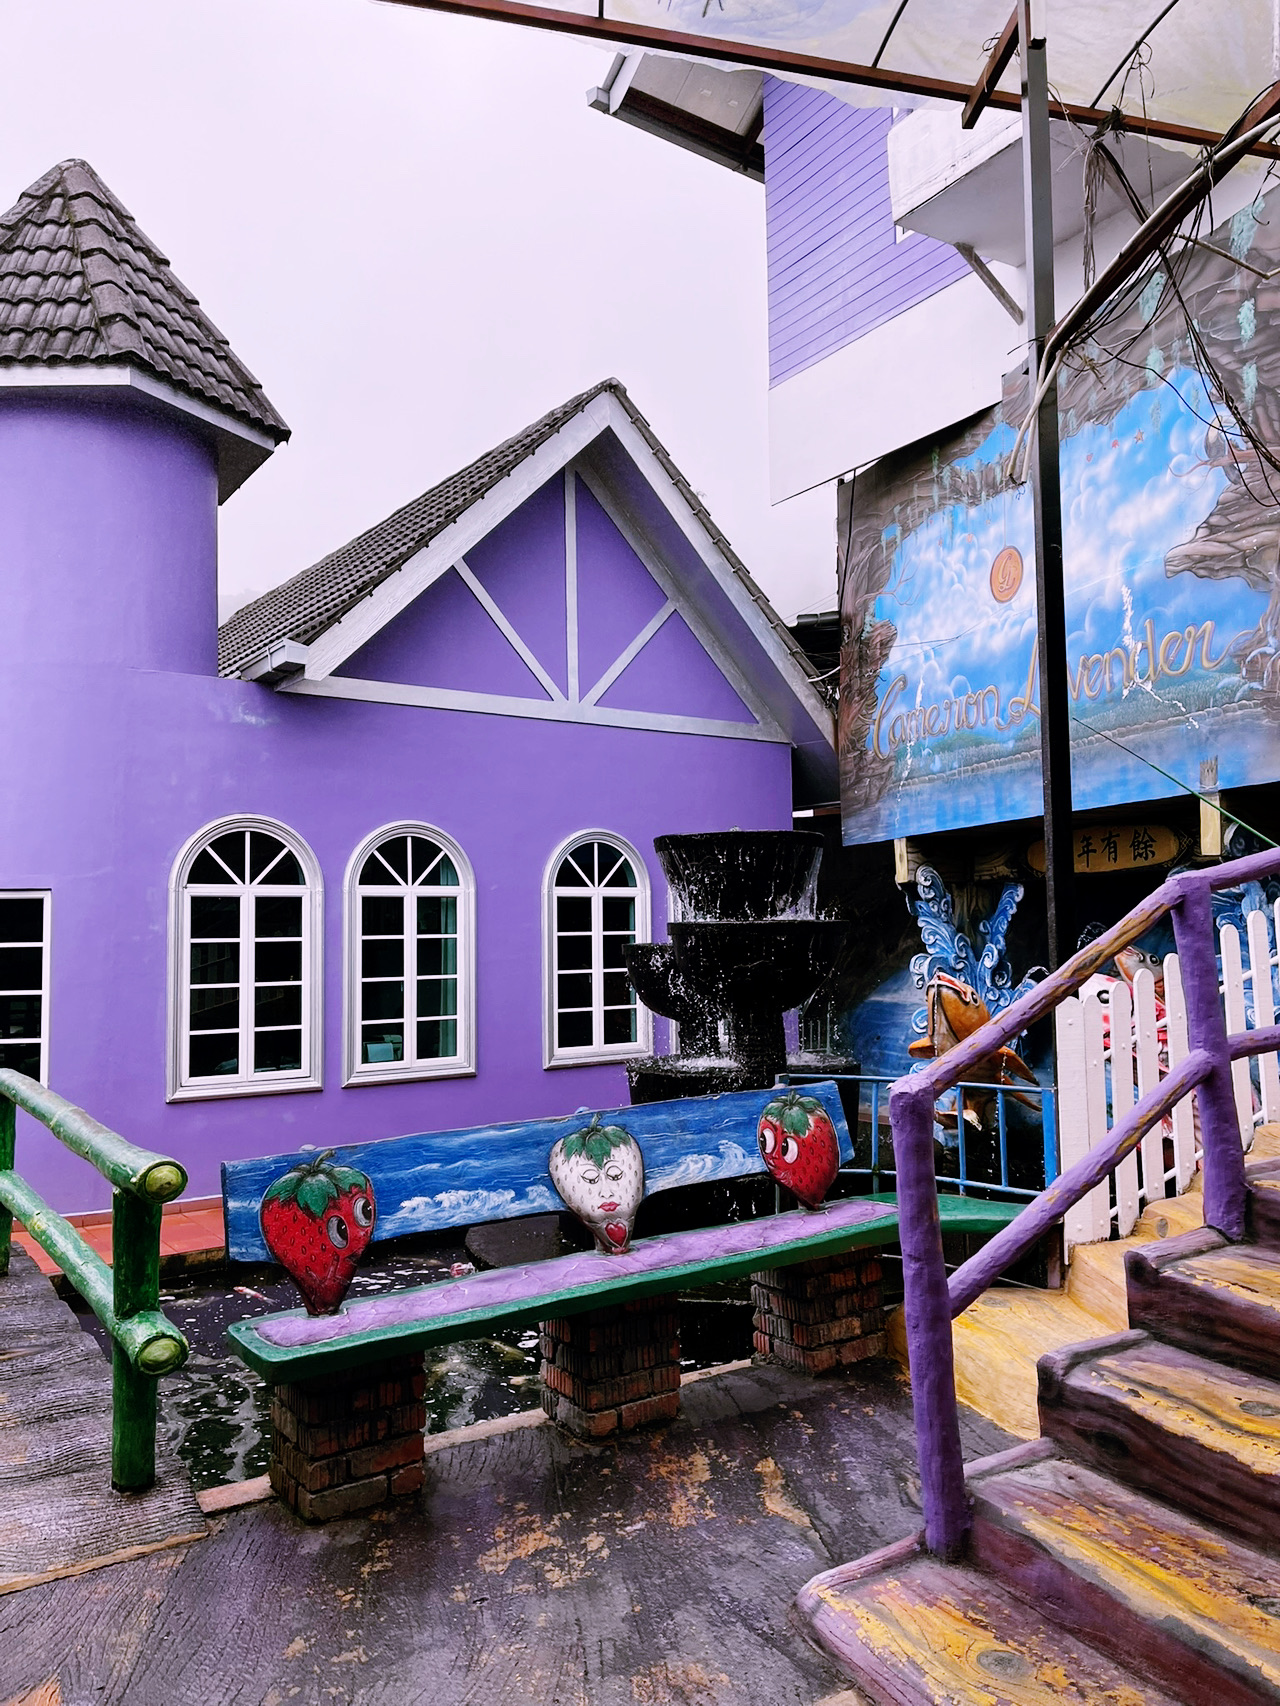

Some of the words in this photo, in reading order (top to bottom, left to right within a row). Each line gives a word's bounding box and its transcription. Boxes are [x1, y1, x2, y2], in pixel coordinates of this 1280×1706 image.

[872, 673, 1008, 760] Cameron
[1008, 618, 1232, 725] Lvender
[1076, 827, 1158, 869] 年有餘
